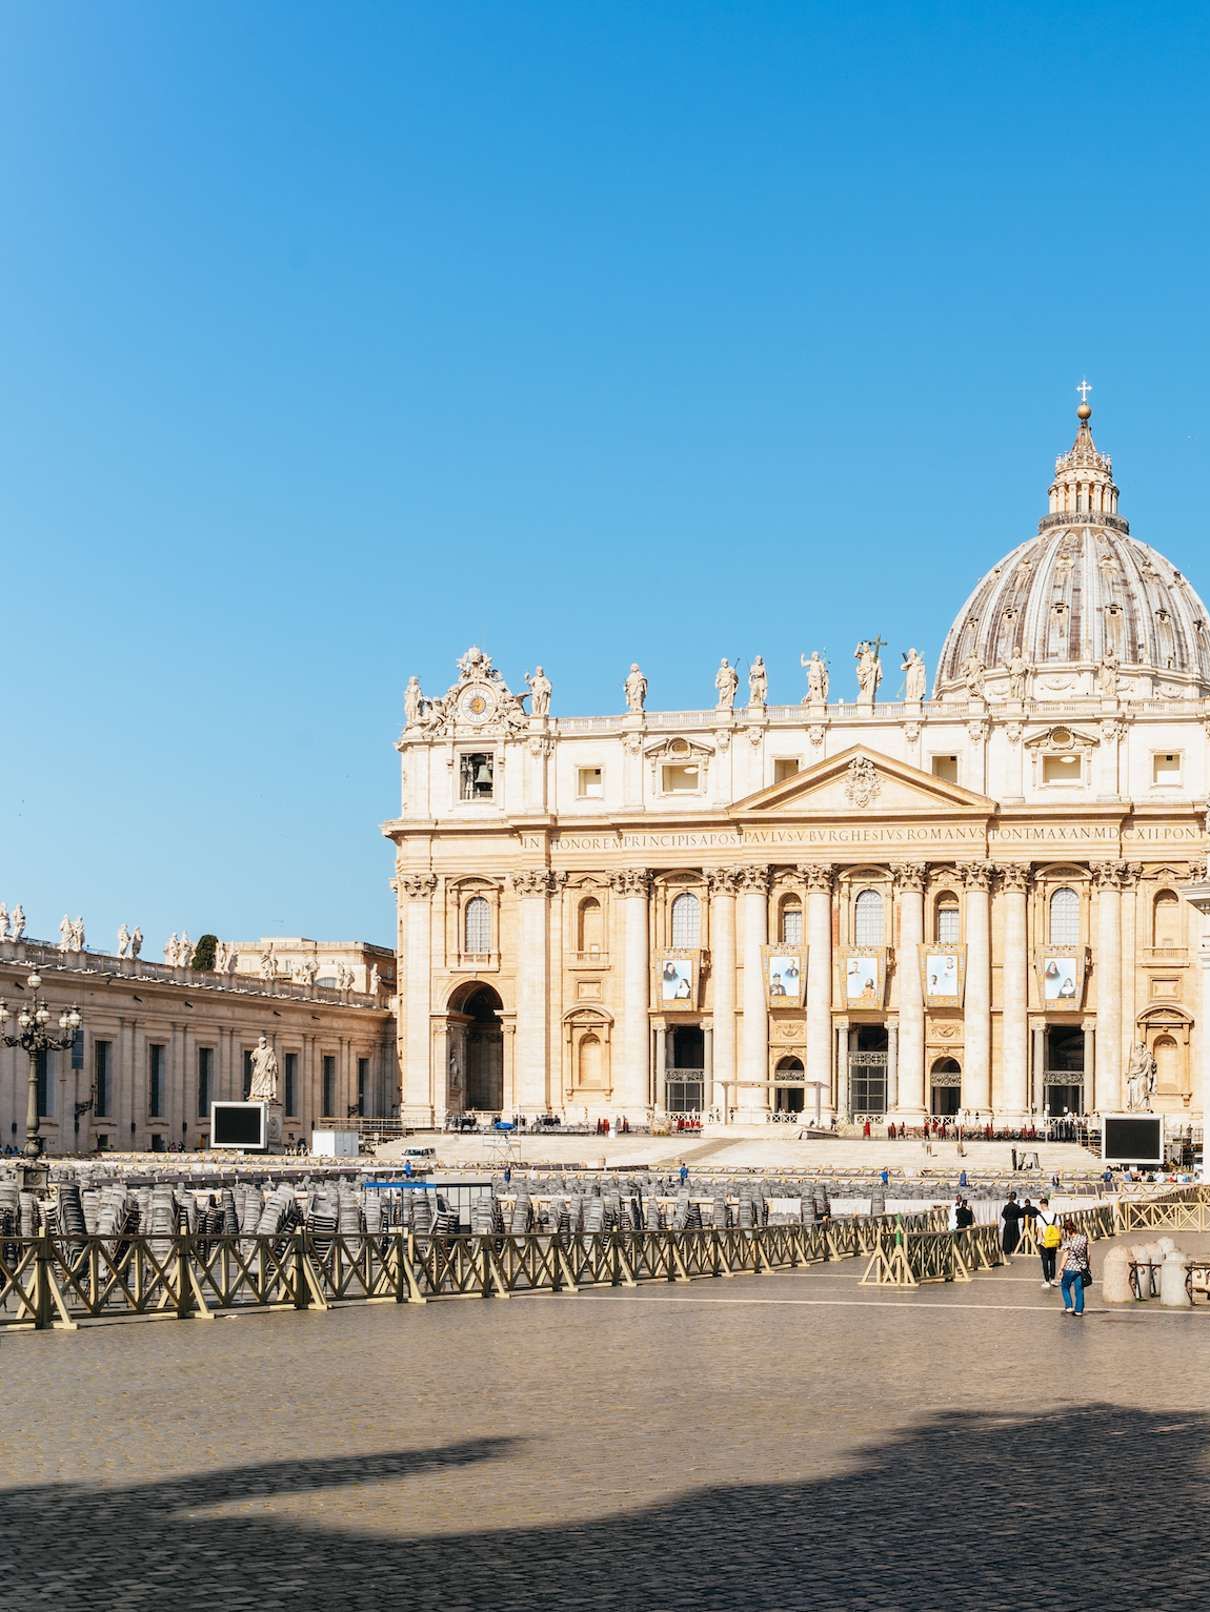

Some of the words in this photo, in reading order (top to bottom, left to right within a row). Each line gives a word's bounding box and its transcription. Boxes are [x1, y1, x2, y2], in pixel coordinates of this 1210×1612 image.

[524, 838, 540, 849] IN
[551, 837, 623, 850] HONOREM
[624, 834, 697, 848] PRINCIPIS
[809, 829, 903, 842] BVRGHESIVS
[907, 827, 985, 840] ROMANVS
